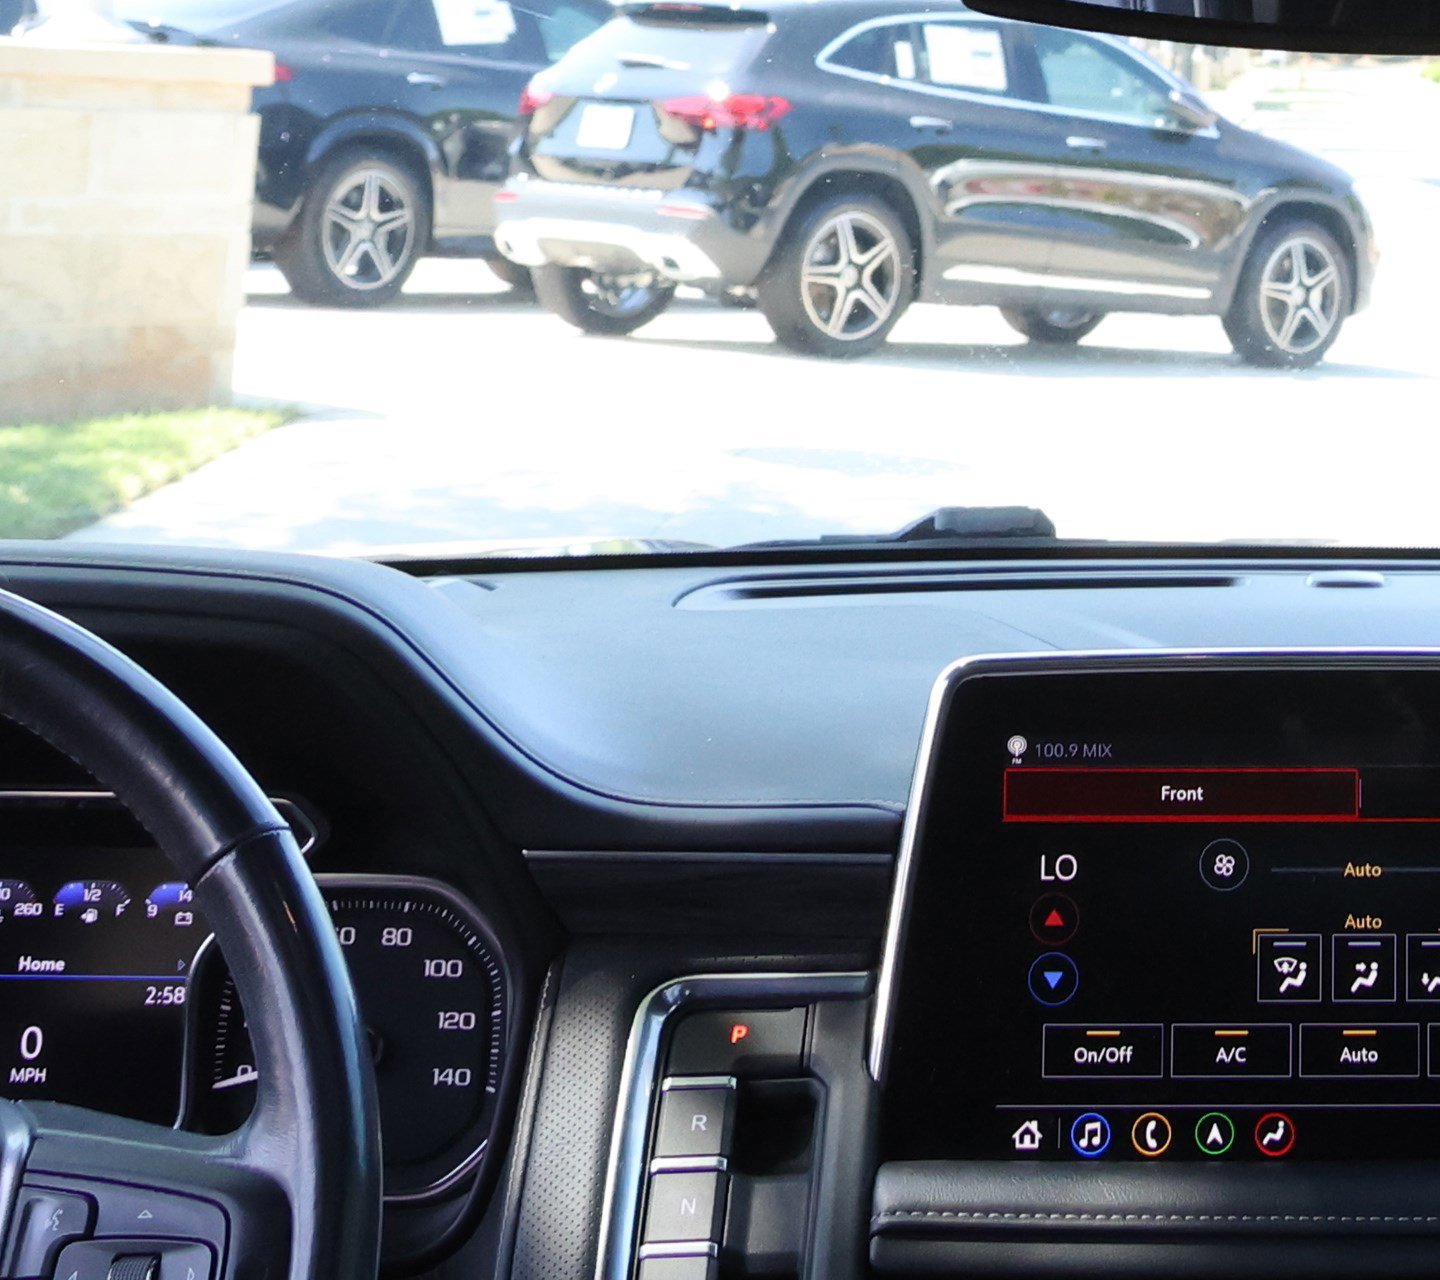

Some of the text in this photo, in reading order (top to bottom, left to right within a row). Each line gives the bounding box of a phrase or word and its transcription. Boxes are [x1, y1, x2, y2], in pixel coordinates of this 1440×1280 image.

[1034, 741, 1113, 759] 100.9 MIX
[1160, 784, 1204, 802] Front
[1039, 853, 1079, 883] LO
[1343, 860, 1382, 878] Auto
[83, 888, 102, 902] 1/2
[13, 903, 44, 917] 260
[54, 903, 65, 917] E
[114, 903, 126, 917] F
[146, 904, 158, 918] 9
[1343, 912, 1383, 930] Auto
[381, 926, 413, 947] 80
[18, 956, 66, 972] Home
[423, 958, 463, 978] 100
[144, 986, 187, 1007] 2:58
[437, 1011, 476, 1030] 120
[20, 1026, 44, 1060] 0
[731, 1025, 747, 1043] P
[1073, 1045, 1134, 1065] On/Off
[1215, 1045, 1248, 1065] A/C
[1339, 1045, 1379, 1064] Auto
[9, 1068, 47, 1084] MPH
[432, 1067, 471, 1087] 140
[691, 1113, 708, 1131] R
[680, 1197, 696, 1214] N
